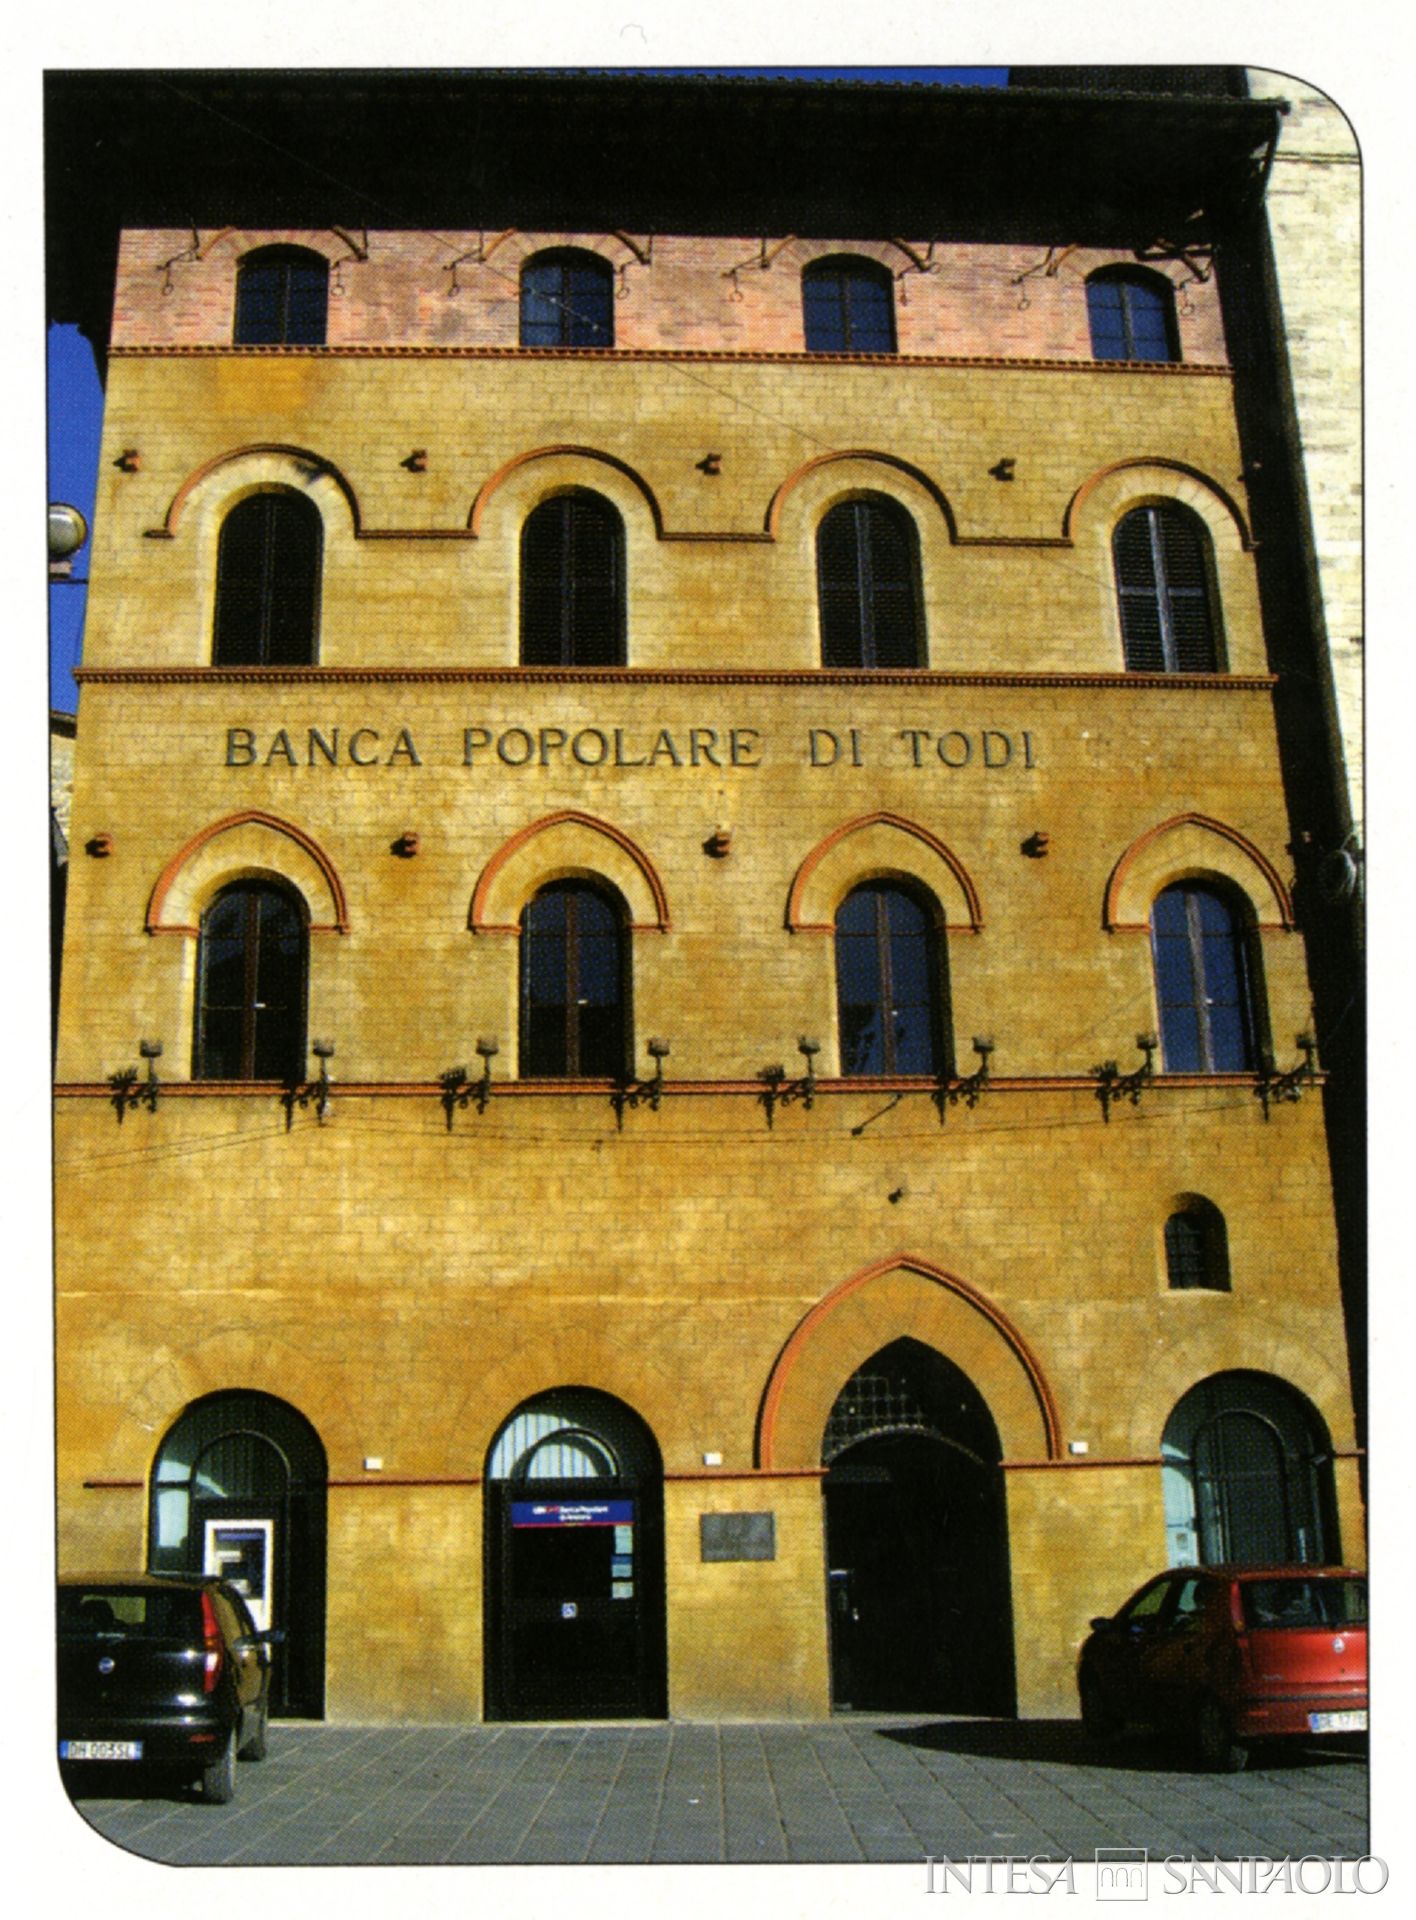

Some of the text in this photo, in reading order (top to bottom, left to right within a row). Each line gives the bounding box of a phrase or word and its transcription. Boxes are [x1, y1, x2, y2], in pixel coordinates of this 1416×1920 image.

[224, 727, 1037, 769] BANCA POPOLARE DI TODI
